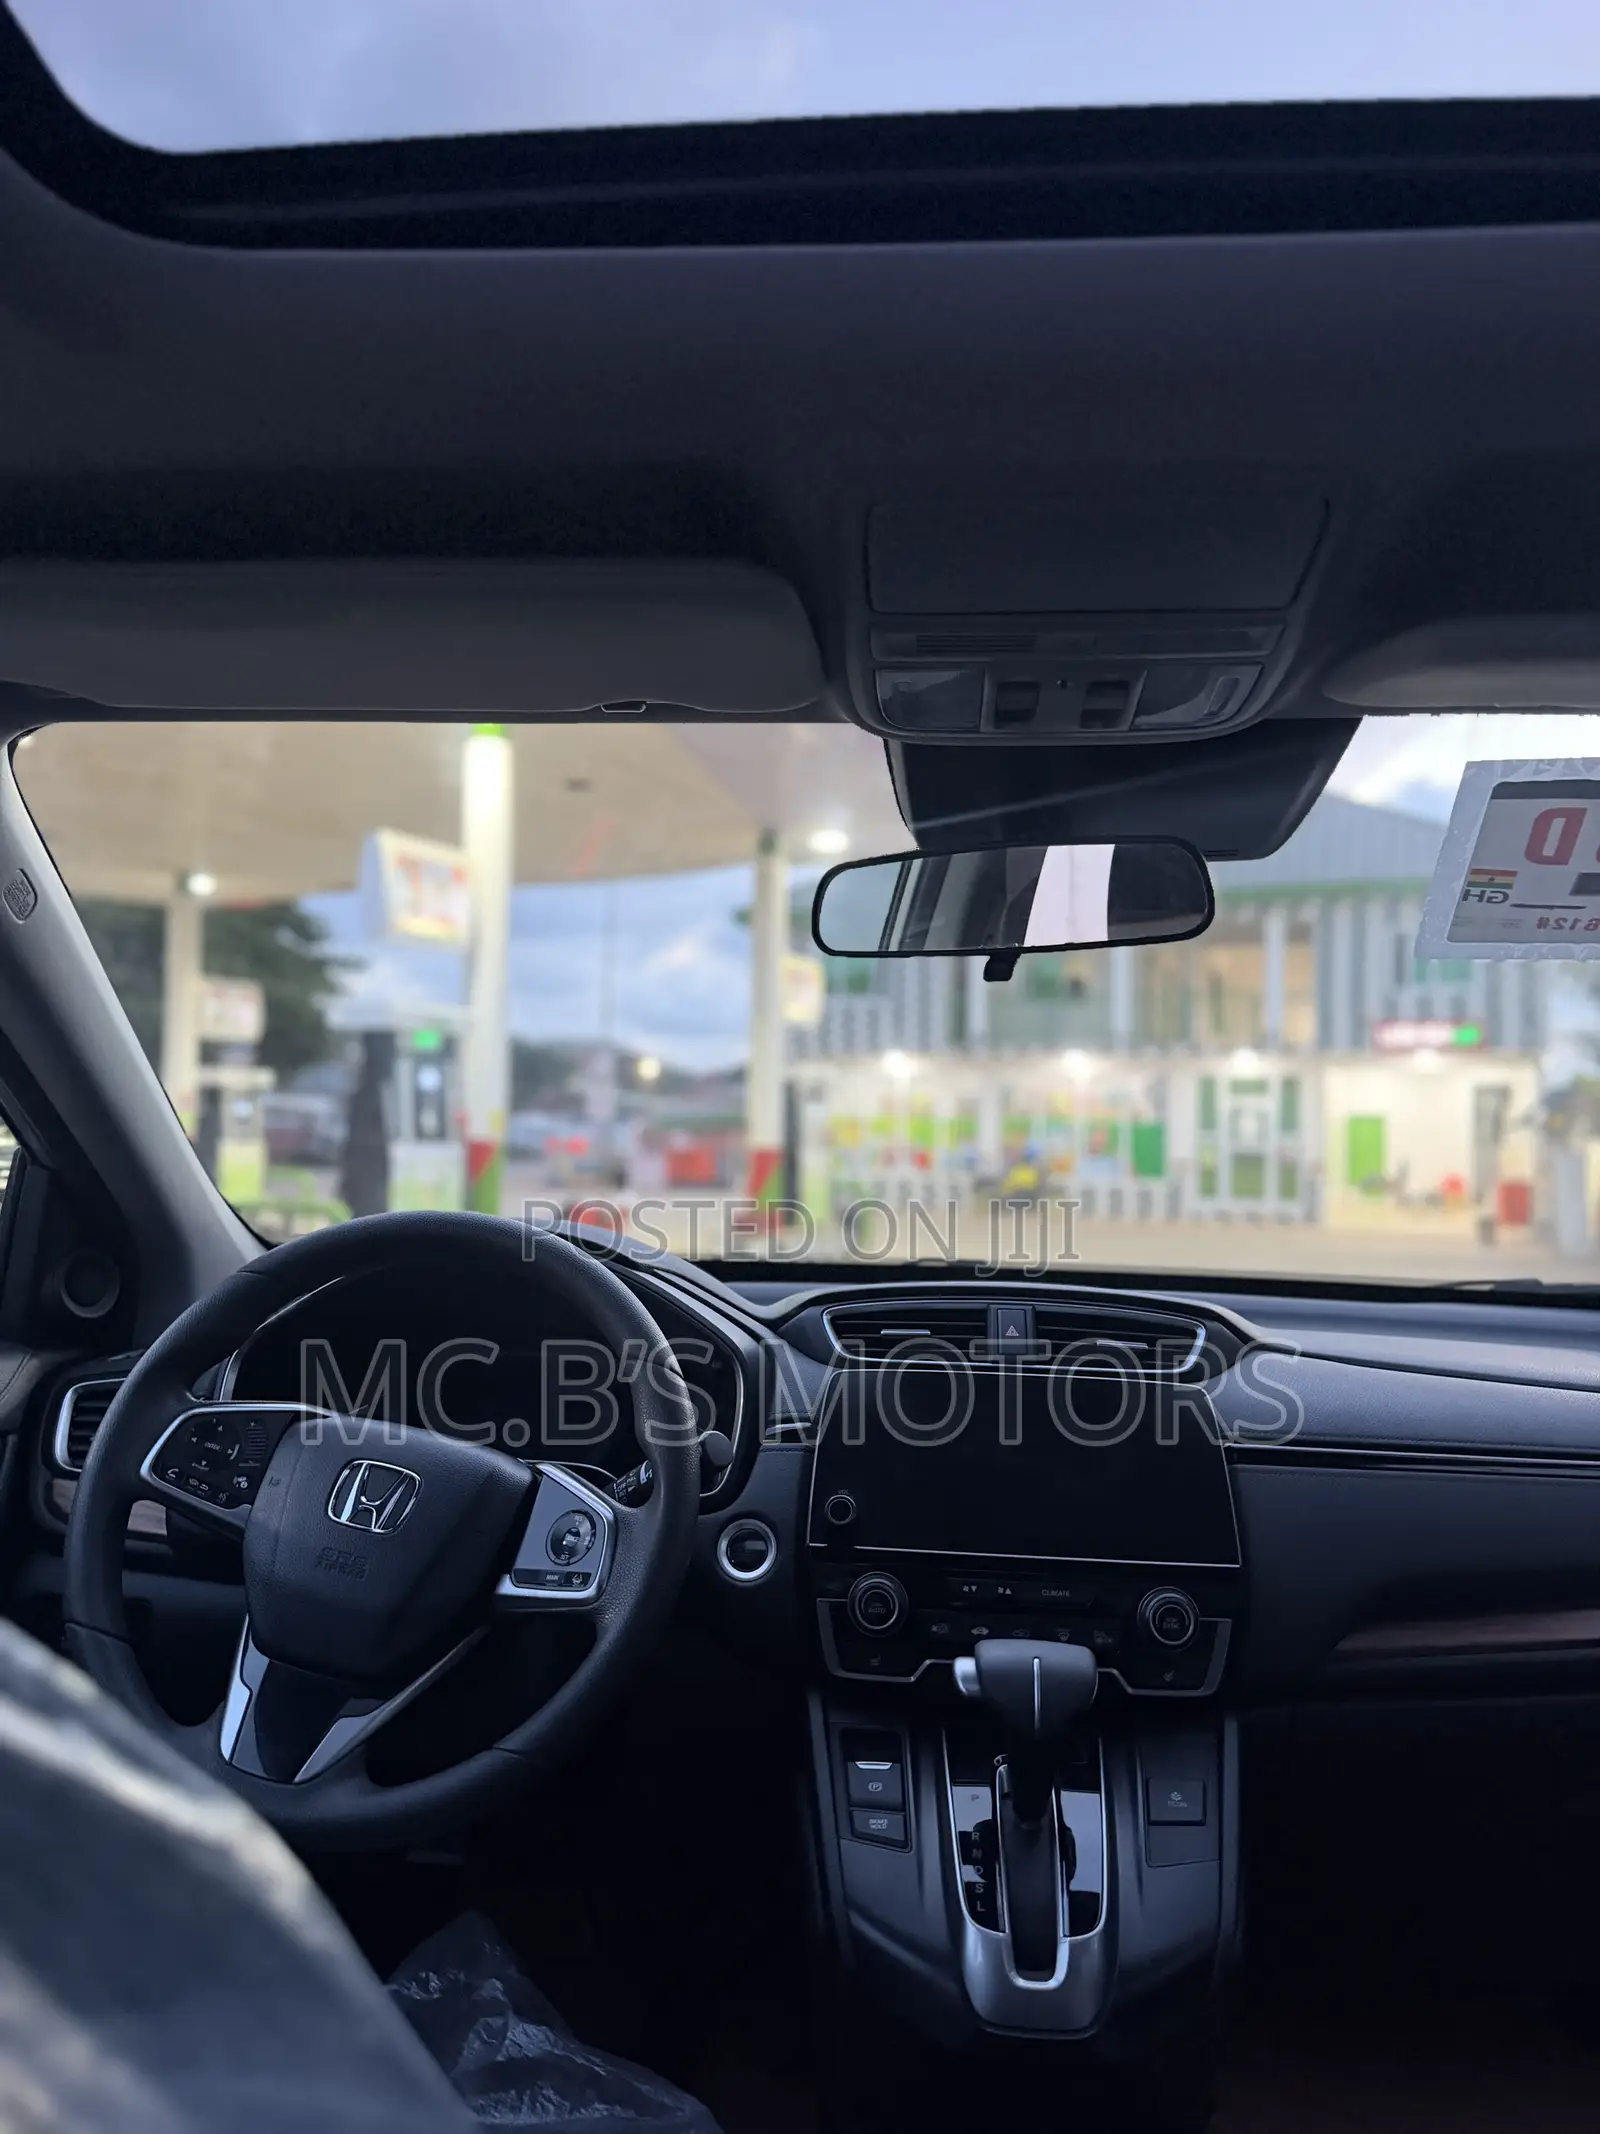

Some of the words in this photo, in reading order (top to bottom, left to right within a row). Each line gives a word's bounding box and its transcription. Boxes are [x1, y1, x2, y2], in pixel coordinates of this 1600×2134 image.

[1041, 1588, 1071, 1597] CLIMATE
[971, 1832, 980, 1840] R
[975, 1884, 985, 1893] S
[976, 1900, 987, 1912] L
